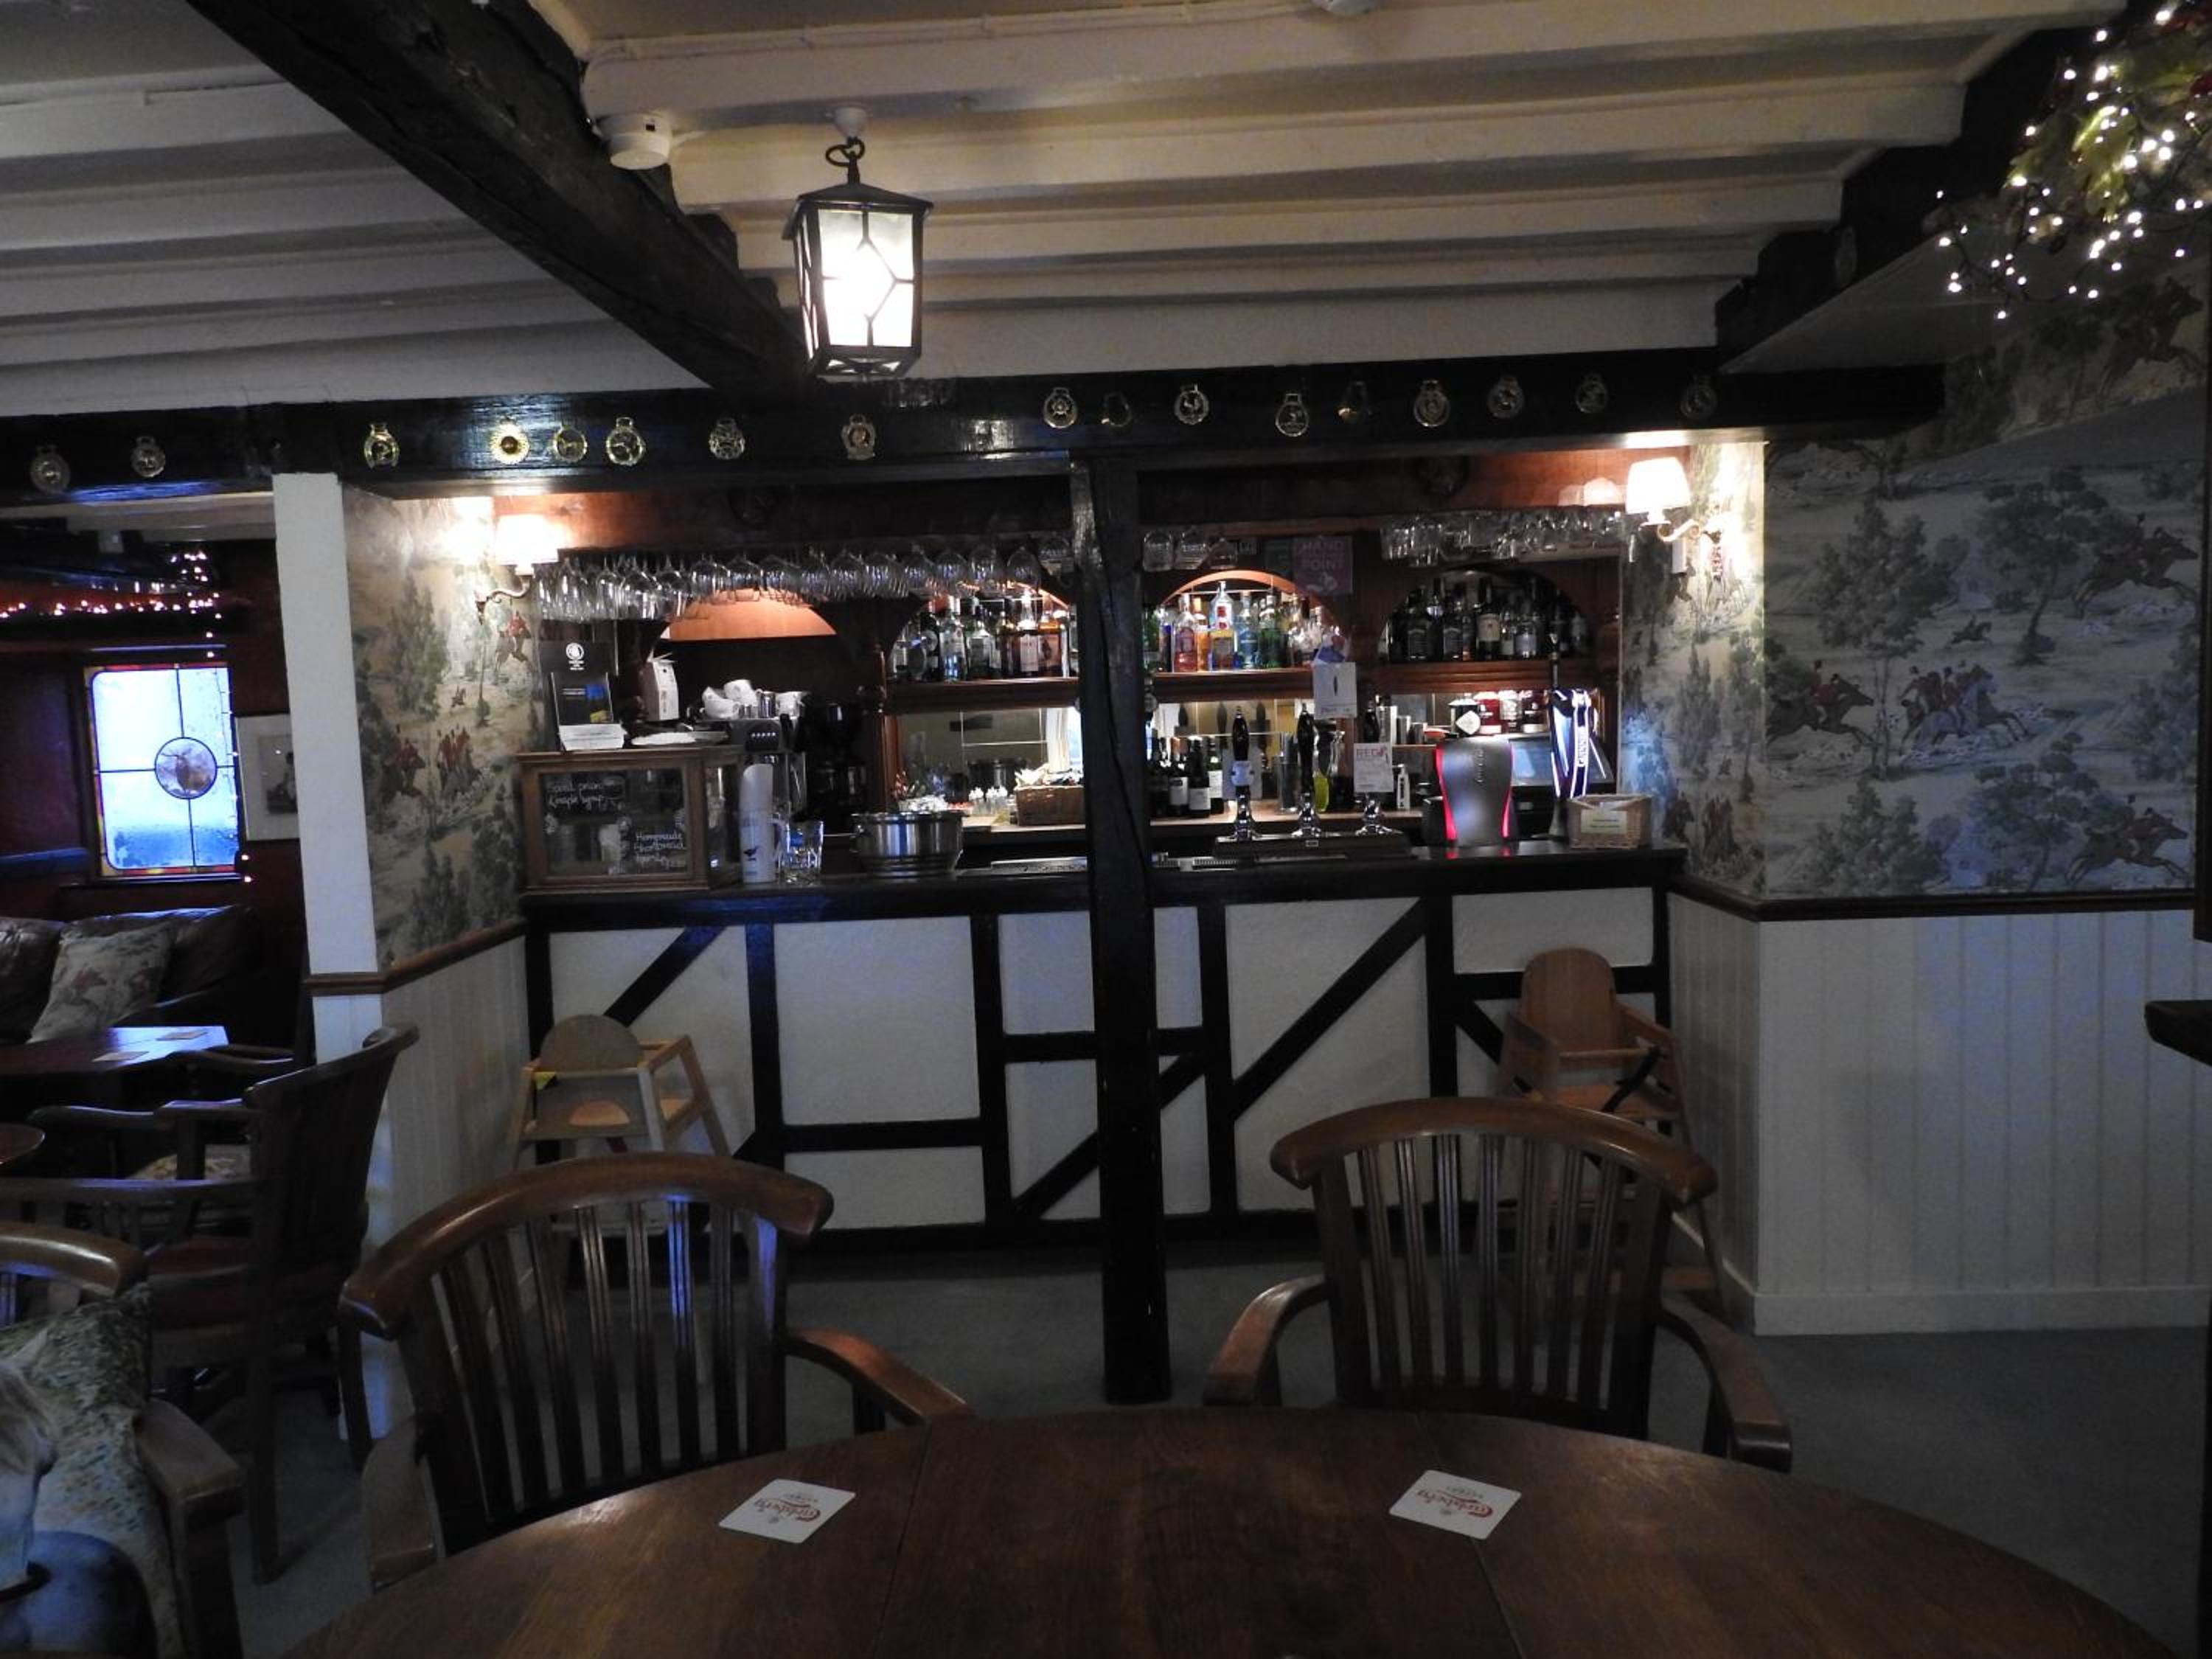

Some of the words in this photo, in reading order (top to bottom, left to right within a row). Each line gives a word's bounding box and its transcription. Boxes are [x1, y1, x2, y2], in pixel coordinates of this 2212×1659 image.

[1299, 541, 1344, 553] HAND
[1300, 556, 1344, 571] POINT
[754, 1498, 821, 1522] Carlsberg
[1416, 1489, 1494, 1518] Carlsberg
